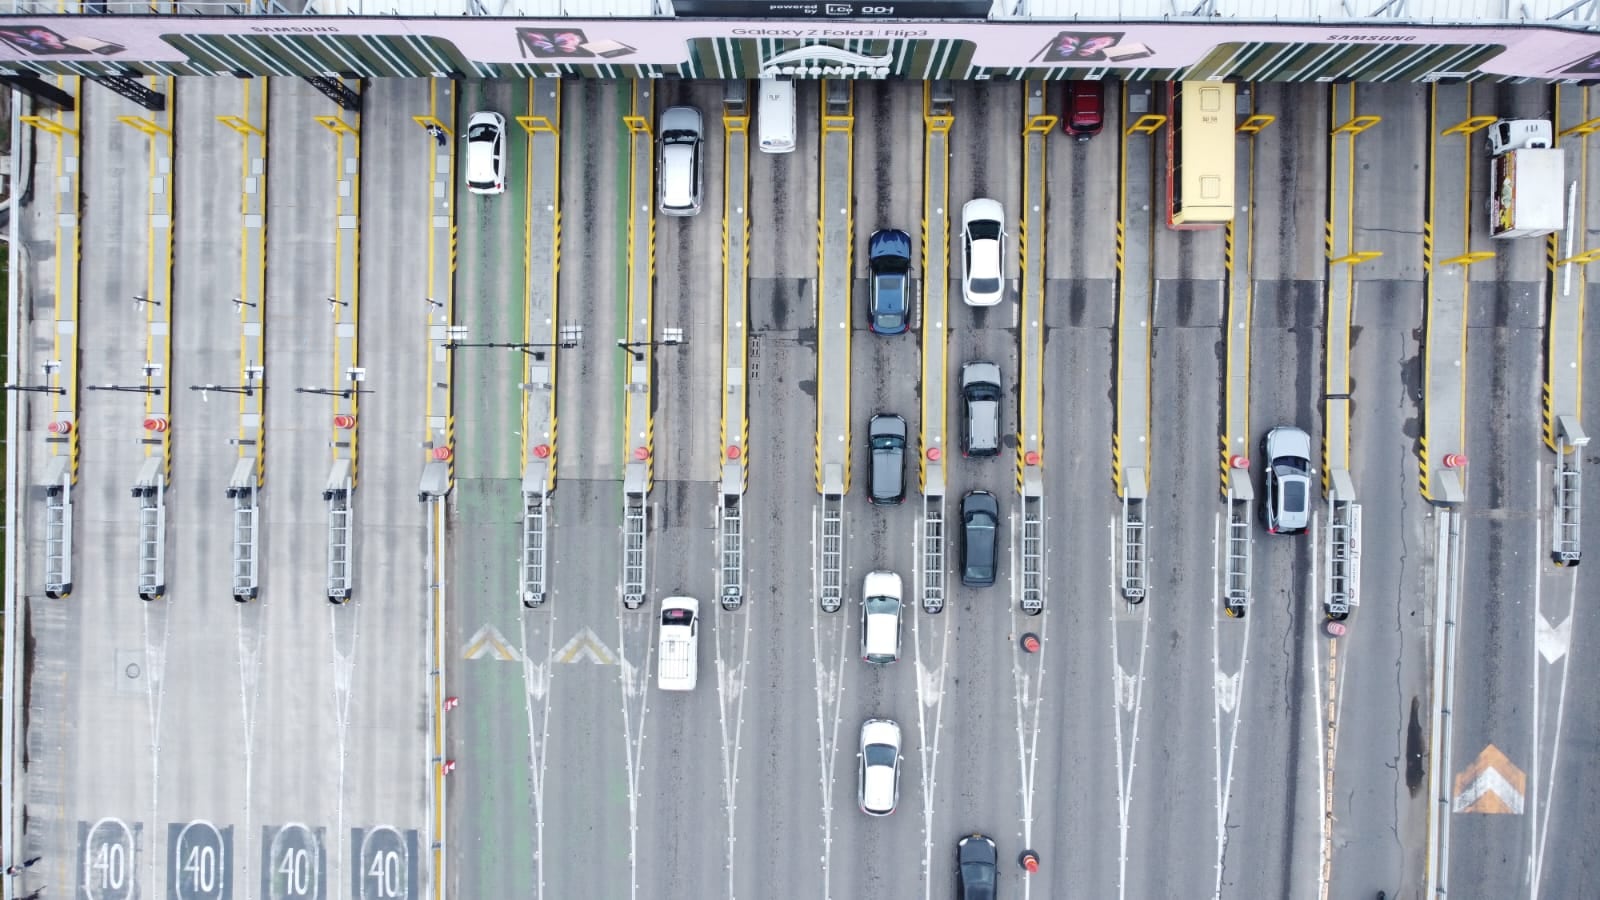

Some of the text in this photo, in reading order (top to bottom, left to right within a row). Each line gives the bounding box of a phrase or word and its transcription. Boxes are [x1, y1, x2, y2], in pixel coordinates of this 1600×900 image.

[731, 28, 803, 37] Galaxy
[884, 29, 928, 38] Flip3
[93, 842, 124, 889] 40
[183, 845, 216, 892] 40
[278, 847, 309, 895] 40
[368, 850, 399, 898] 40
